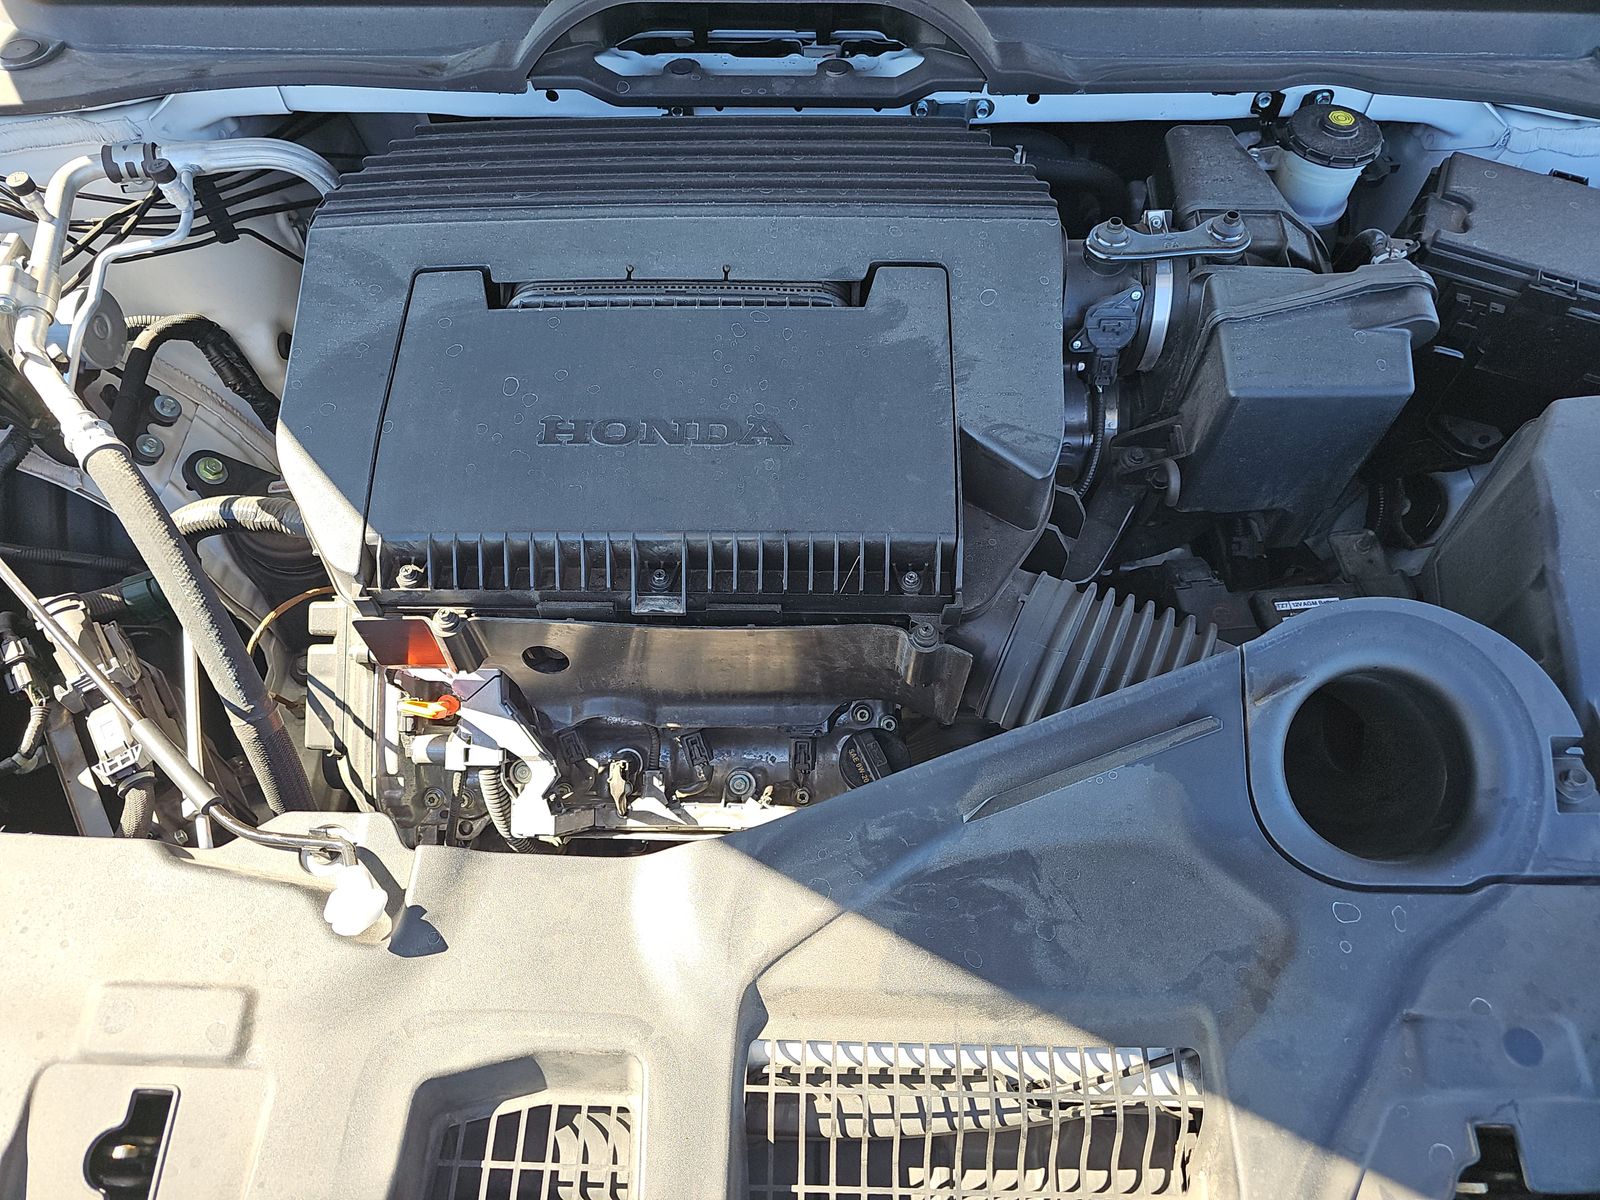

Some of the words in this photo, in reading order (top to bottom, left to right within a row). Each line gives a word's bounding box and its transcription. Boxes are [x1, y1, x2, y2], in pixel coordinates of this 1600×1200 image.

[536, 418, 794, 447] HONDA
[849, 748, 860, 763] SAE
[856, 763, 870, 783] 0W-20
